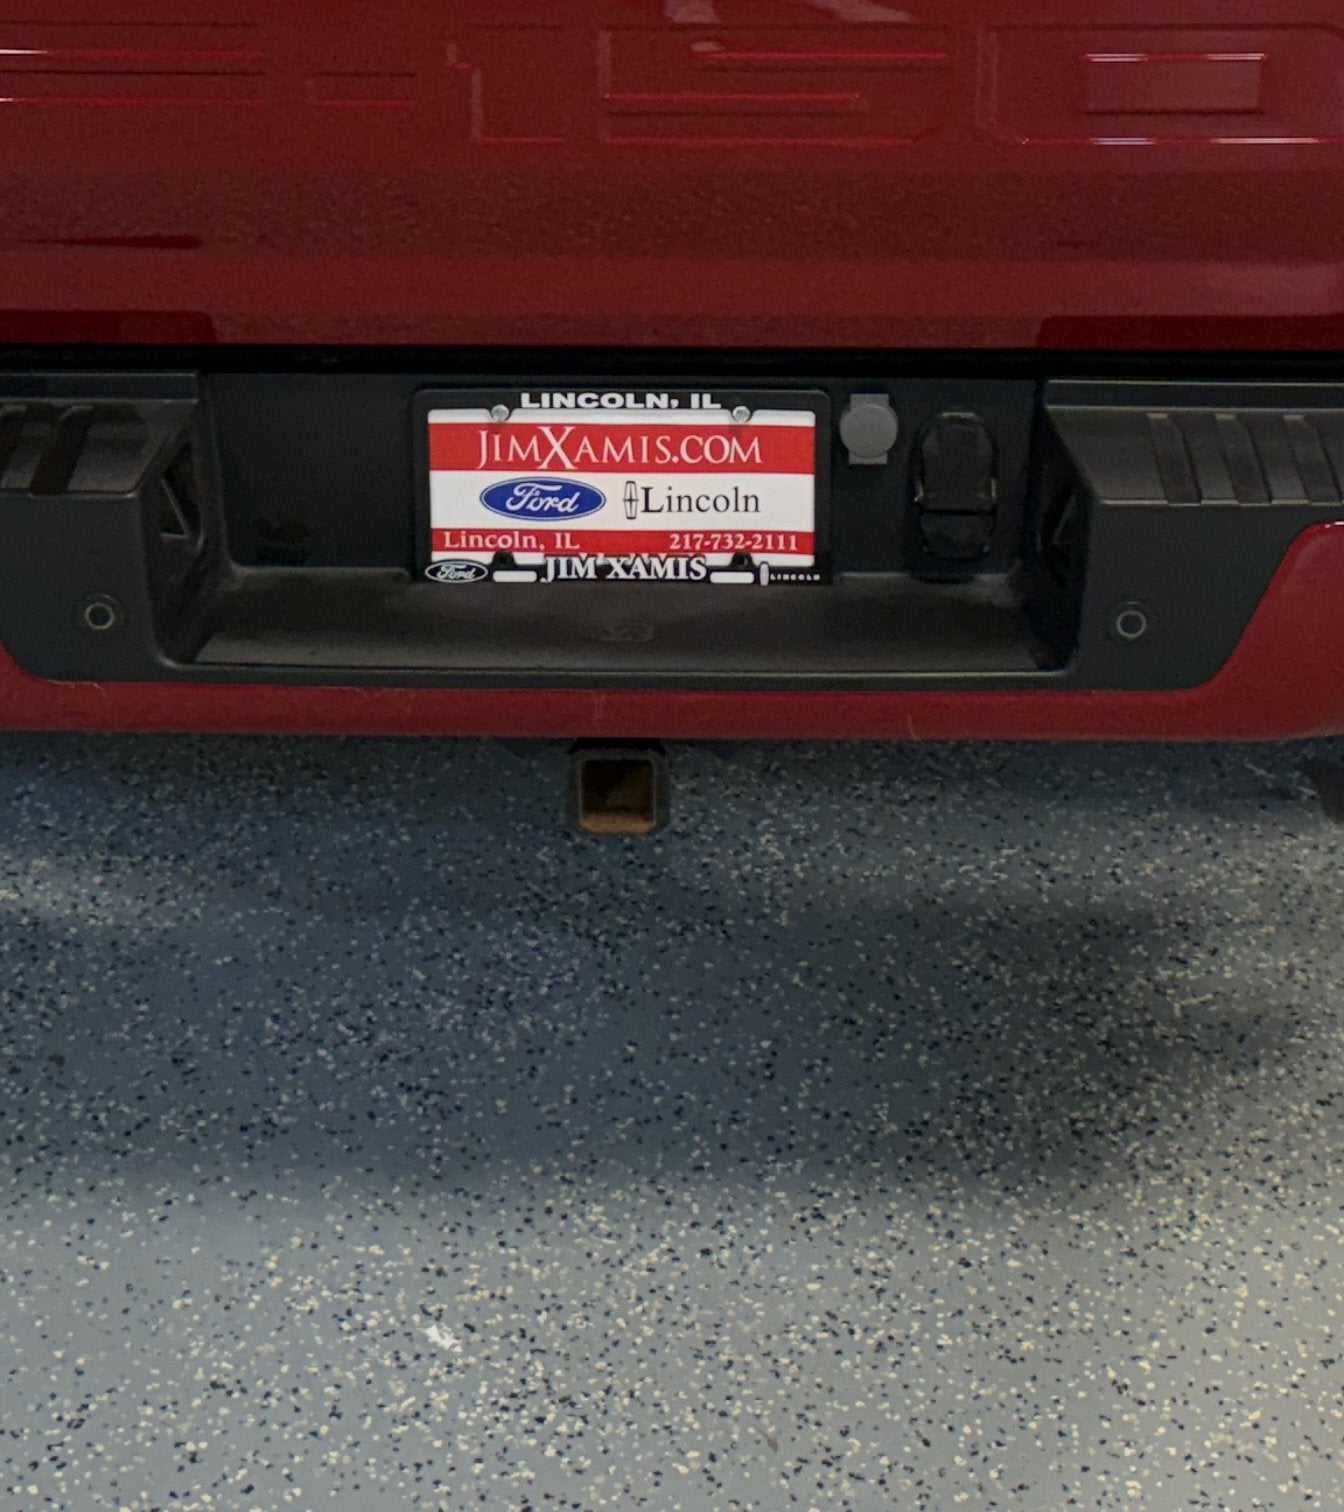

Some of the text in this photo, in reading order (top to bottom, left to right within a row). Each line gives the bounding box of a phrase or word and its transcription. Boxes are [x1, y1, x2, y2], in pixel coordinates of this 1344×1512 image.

[520, 392, 722, 409] LINCOLN, IL
[478, 425, 762, 470] JIMXAMIS.COM
[505, 481, 580, 515] Ford
[640, 485, 761, 515] Lincoln
[443, 530, 581, 551] Lincoln, IL
[669, 533, 798, 551] 217-732-2111
[436, 564, 476, 580] Ford
[539, 555, 707, 584] JIM XAMIS
[770, 573, 821, 581] LINCOLN
